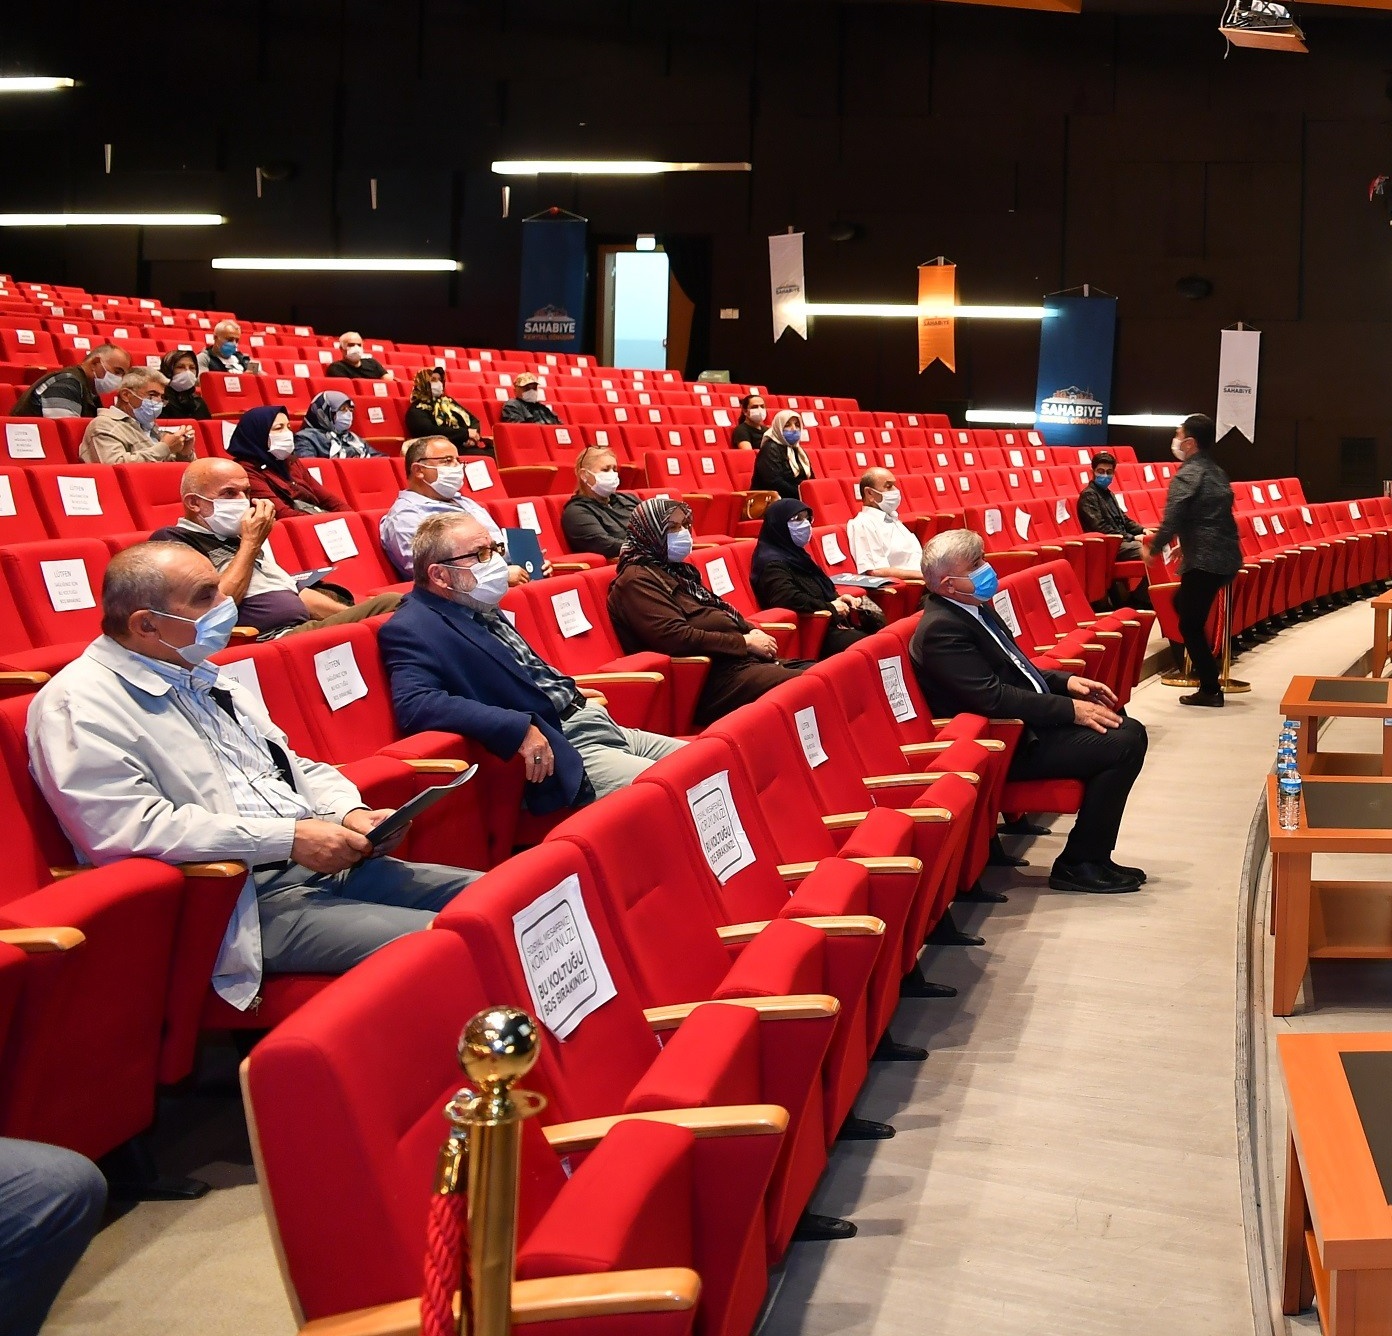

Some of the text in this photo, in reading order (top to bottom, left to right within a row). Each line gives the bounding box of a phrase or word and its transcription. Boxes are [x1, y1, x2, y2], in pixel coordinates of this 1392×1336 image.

[1041, 403, 1103, 417] SAHABİYE
[531, 926, 577, 973] KORUYUNUZ!
[538, 950, 584, 1001] BU KOLTUĞU
[544, 996, 557, 1017] BOŞ
